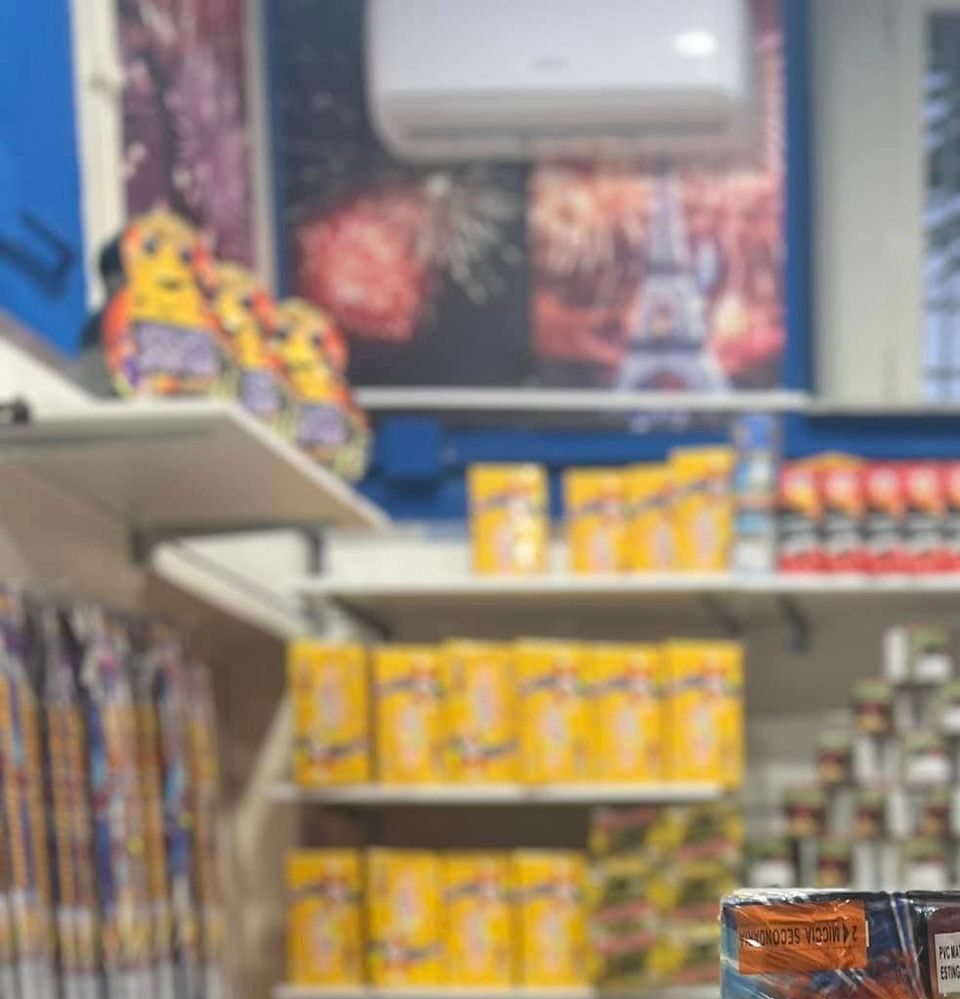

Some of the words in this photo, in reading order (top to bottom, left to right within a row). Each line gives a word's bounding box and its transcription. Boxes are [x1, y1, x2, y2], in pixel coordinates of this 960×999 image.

[806, 926, 842, 946] MICCIA
[852, 925, 858, 942] 2
[939, 946, 950, 960] PVC
